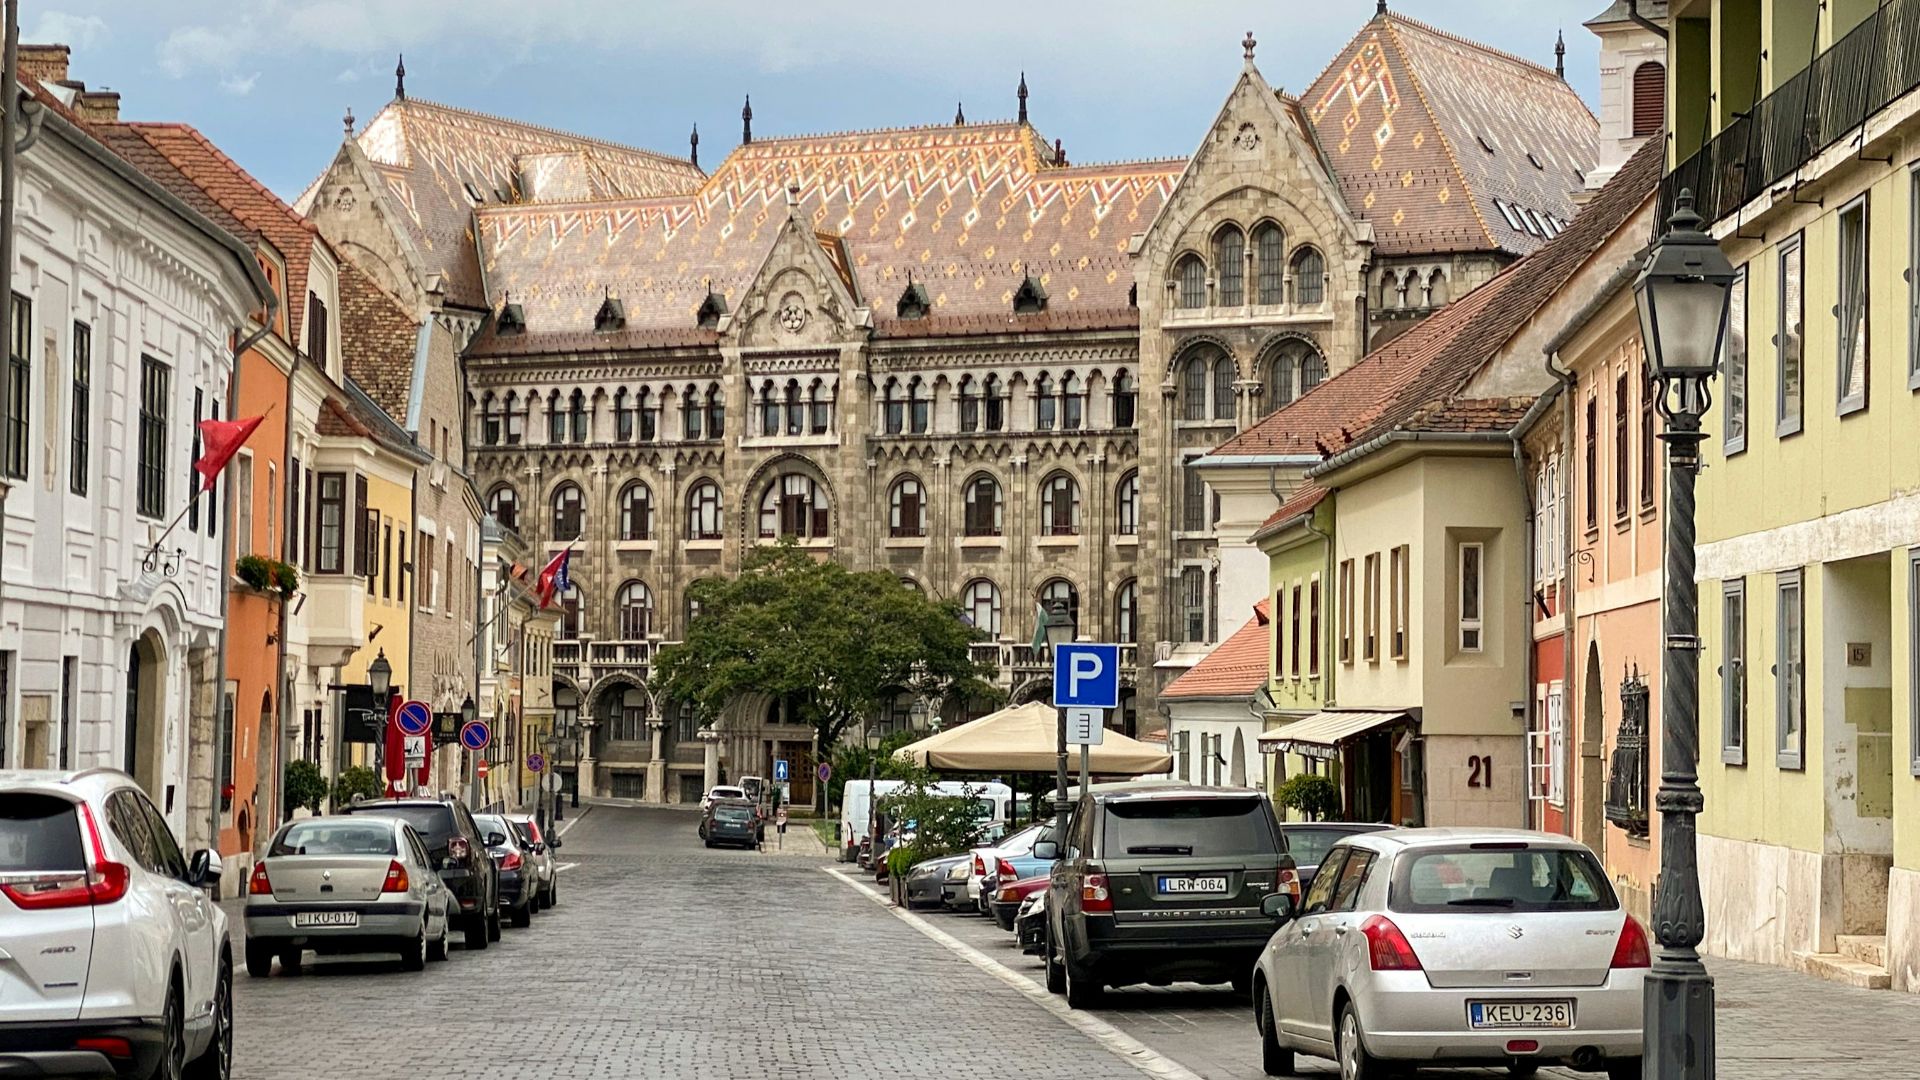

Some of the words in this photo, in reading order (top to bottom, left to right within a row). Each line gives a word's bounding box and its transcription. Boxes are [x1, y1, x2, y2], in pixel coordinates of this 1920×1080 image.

[1853, 648, 1865, 662] 15
[1069, 652, 1103, 698] P
[1467, 754, 1492, 788] 21
[1168, 879, 1223, 891] LRW-064
[308, 912, 355, 924] IKU-017
[1485, 1004, 1566, 1022] KEU-236
